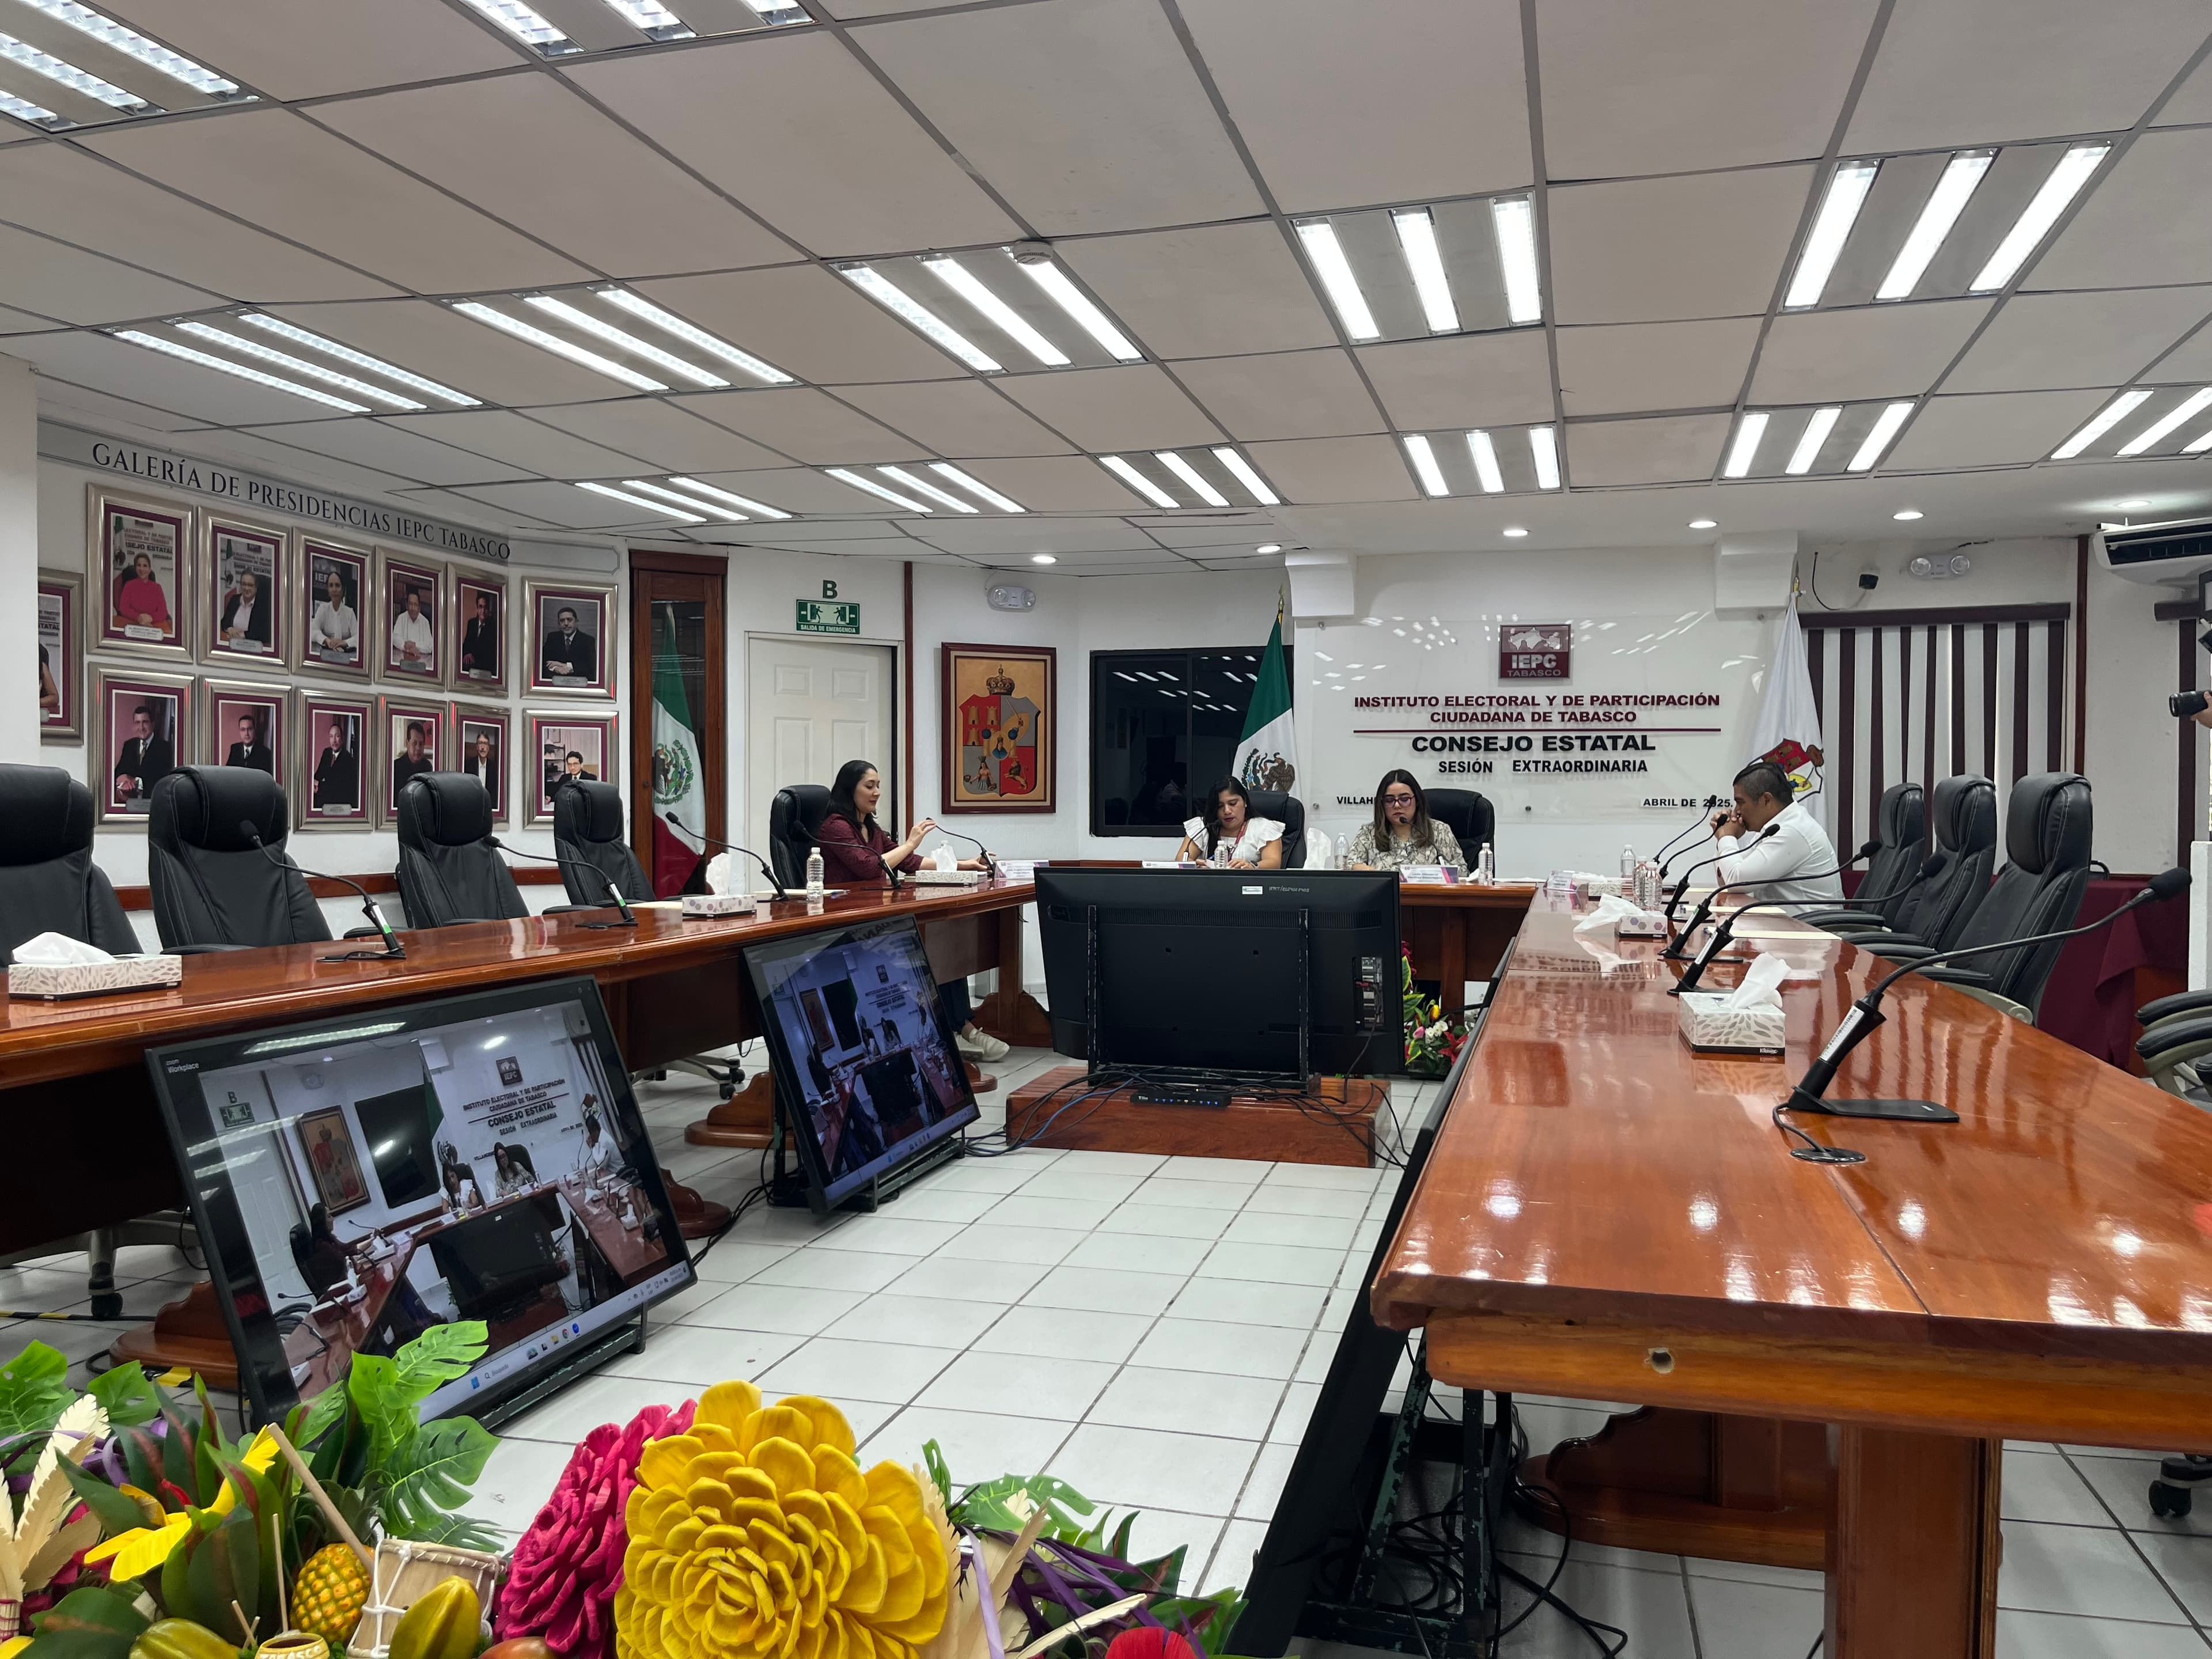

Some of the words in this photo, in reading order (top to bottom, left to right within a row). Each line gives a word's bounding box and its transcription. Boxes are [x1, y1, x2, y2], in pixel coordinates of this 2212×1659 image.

[92, 443, 202, 488] GALERÍA
[211, 471, 240, 497] DE
[248, 481, 391, 532] PRESIDENCIAS
[397, 517, 434, 542] IEPC
[439, 527, 510, 559] TABASCO
[823, 579, 838, 599] B
[1512, 653, 1558, 669] IEPC
[1507, 669, 1561, 677] TABASCO
[1354, 696, 1439, 707] INSTITUTO
[1445, 695, 1540, 707] ELECTORAL
[1546, 695, 1557, 706] Y
[1563, 695, 1584, 706] DE
[1590, 692, 1719, 706] PARTICIPACIÓN
[1430, 711, 1525, 723] CIUDADANA
[1531, 711, 1552, 722] DE
[1558, 711, 1637, 722] TABASCO
[1412, 736, 1533, 752] CONSEJO
[1542, 734, 1656, 751] ESTATAL
[1438, 757, 1493, 773] SESIÓN
[1512, 759, 1647, 772] EXTRAORDINARIA
[1336, 796, 1376, 805] VILLAH
[1643, 798, 1678, 806] ABRIL
[1681, 798, 1696, 807] DE
[167, 1062, 199, 1074] Workplace
[503, 1070, 518, 1080] IEPC
[227, 1091, 238, 1103] B
[463, 1099, 490, 1111] INSTITUTO
[491, 1092, 519, 1105] ELECTORAL
[488, 1100, 517, 1112] CIUDADANA
[525, 1091, 547, 1103] TABASCO
[488, 1110, 524, 1128] CONSEJO
[525, 1101, 556, 1117] ESTATAL
[499, 1124, 517, 1136] SESIÓN
